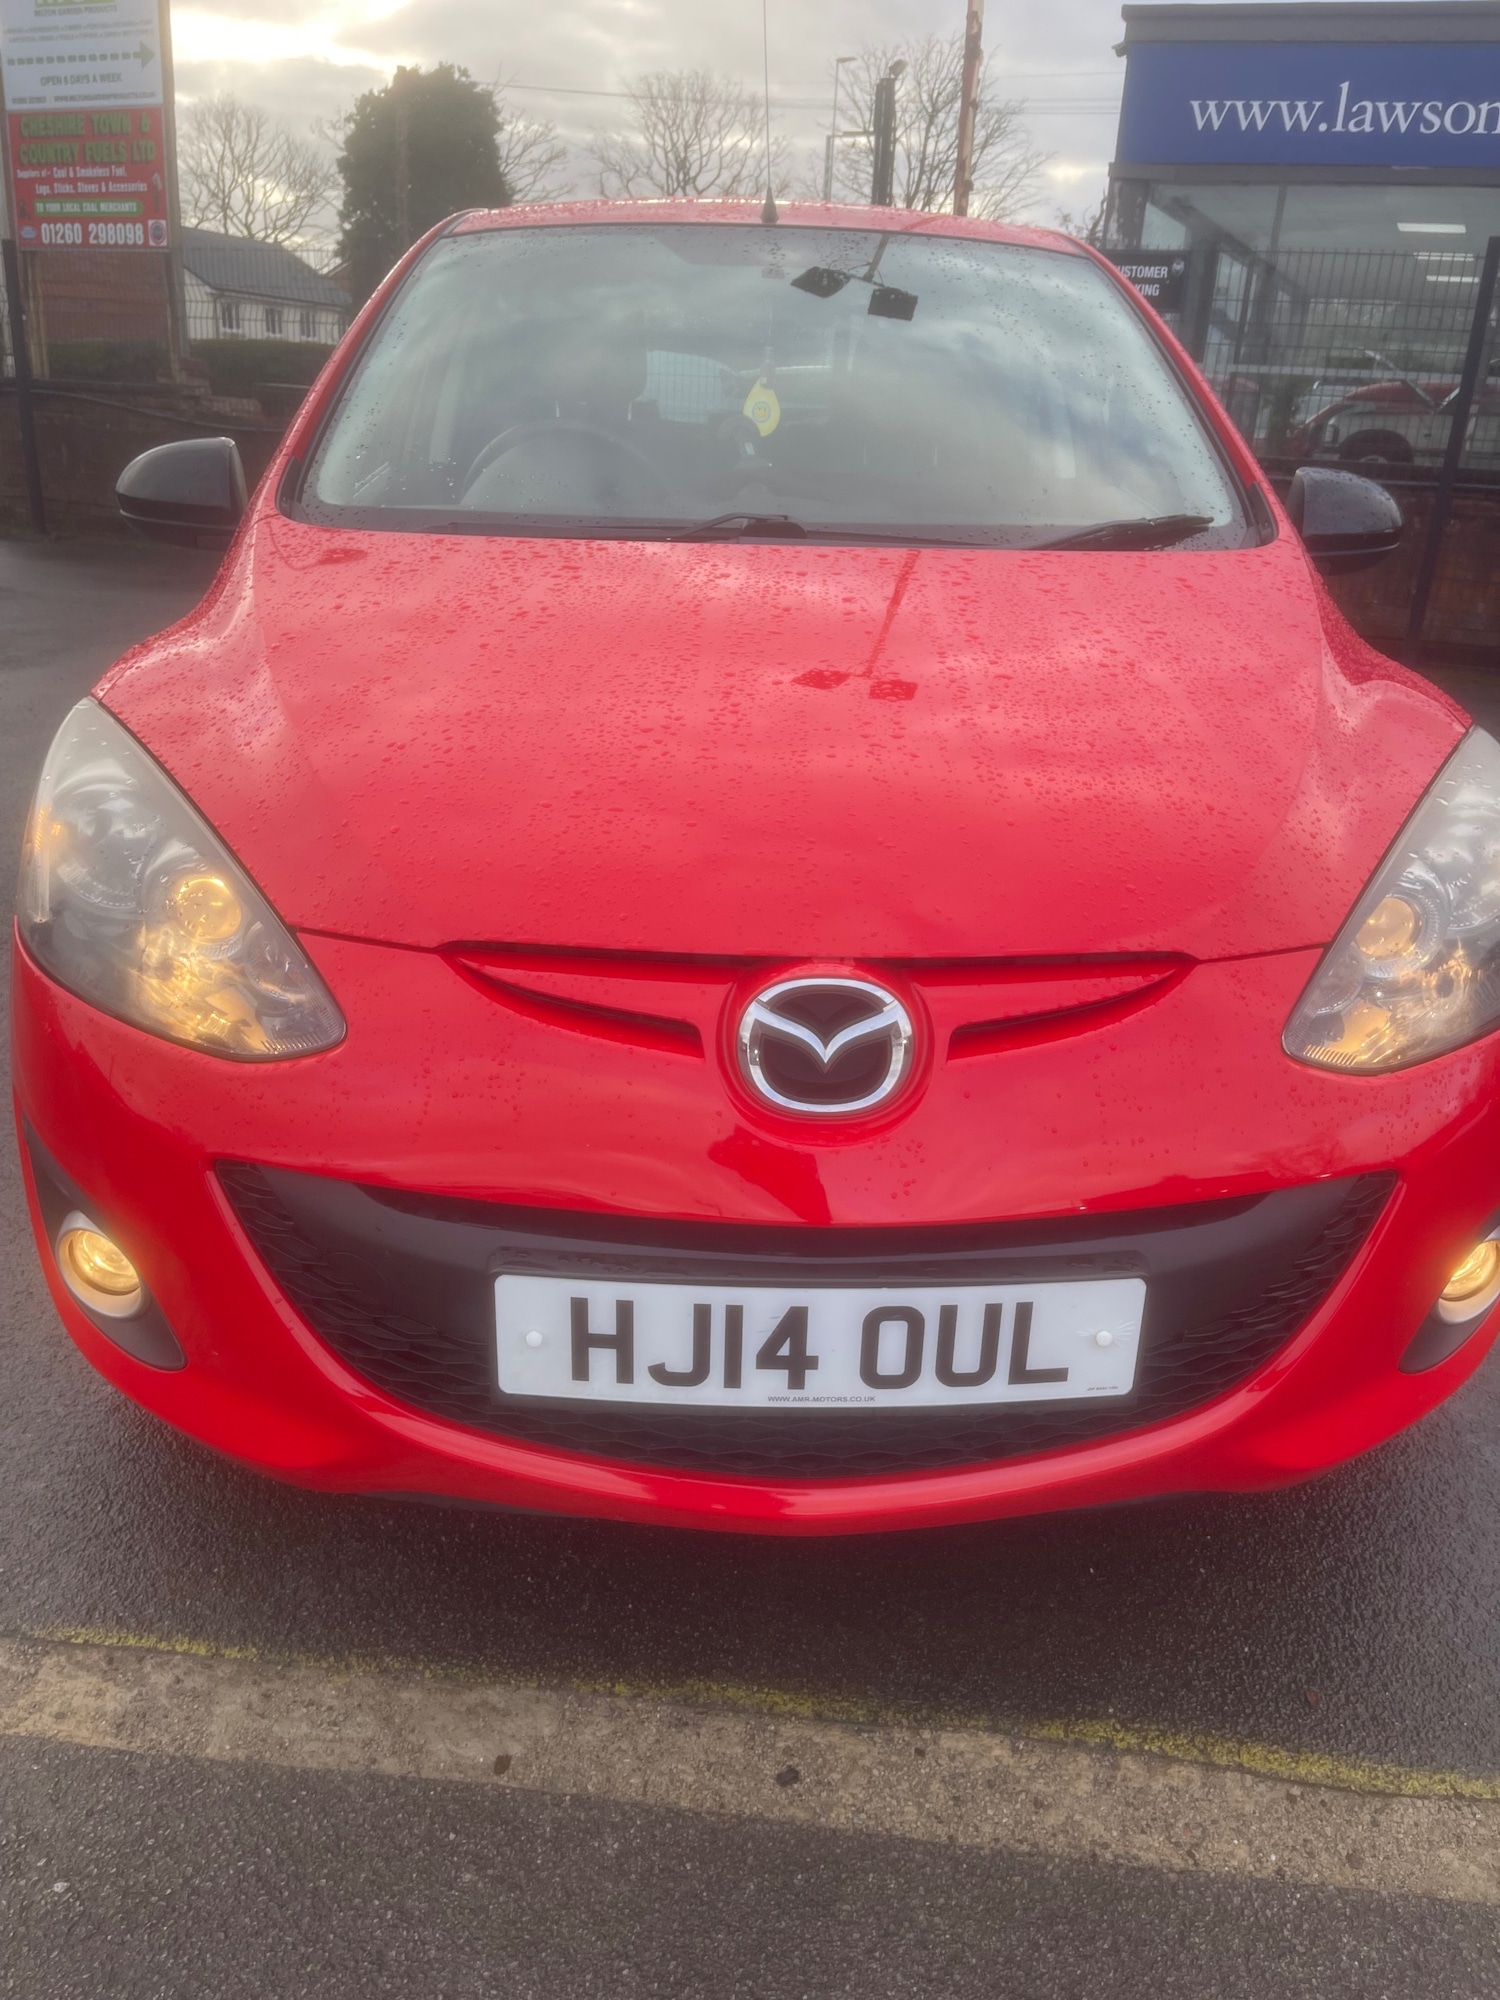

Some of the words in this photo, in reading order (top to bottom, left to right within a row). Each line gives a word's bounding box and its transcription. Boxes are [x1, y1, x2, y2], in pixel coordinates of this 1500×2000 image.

[40, 75, 63, 86] OPEN
[70, 74, 90, 85] DAYS
[92, 73, 98, 83] A
[1190, 81, 1500, 134] www.lawson
[20, 114, 85, 137] CHESHIRE
[91, 112, 131, 135] TOWN
[19, 142, 79, 165] COUNTRY
[84, 141, 127, 163] FUELS
[132, 140, 156, 162] LTD
[53, 166, 67, 178] Coal
[69, 166, 74, 178] &
[76, 165, 110, 178] Smokeless
[77, 181, 99, 193] Stoves
[101, 181, 106, 193] &
[108, 180, 148, 192] Accessories
[36, 202, 44, 213] TO
[62, 202, 81, 212] LOCAL
[82, 202, 98, 212] COAL
[99, 201, 137, 212] MERCHANTS
[41, 222, 82, 245] 01260
[88, 222, 144, 245] 298098
[1117, 265, 1168, 279] USTOMER
[569, 1296, 819, 1390] HJ14
[859, 1301, 1069, 1390] OUL
[767, 1395, 876, 1403] WWW.AMR-MOTORS.CO.UK
